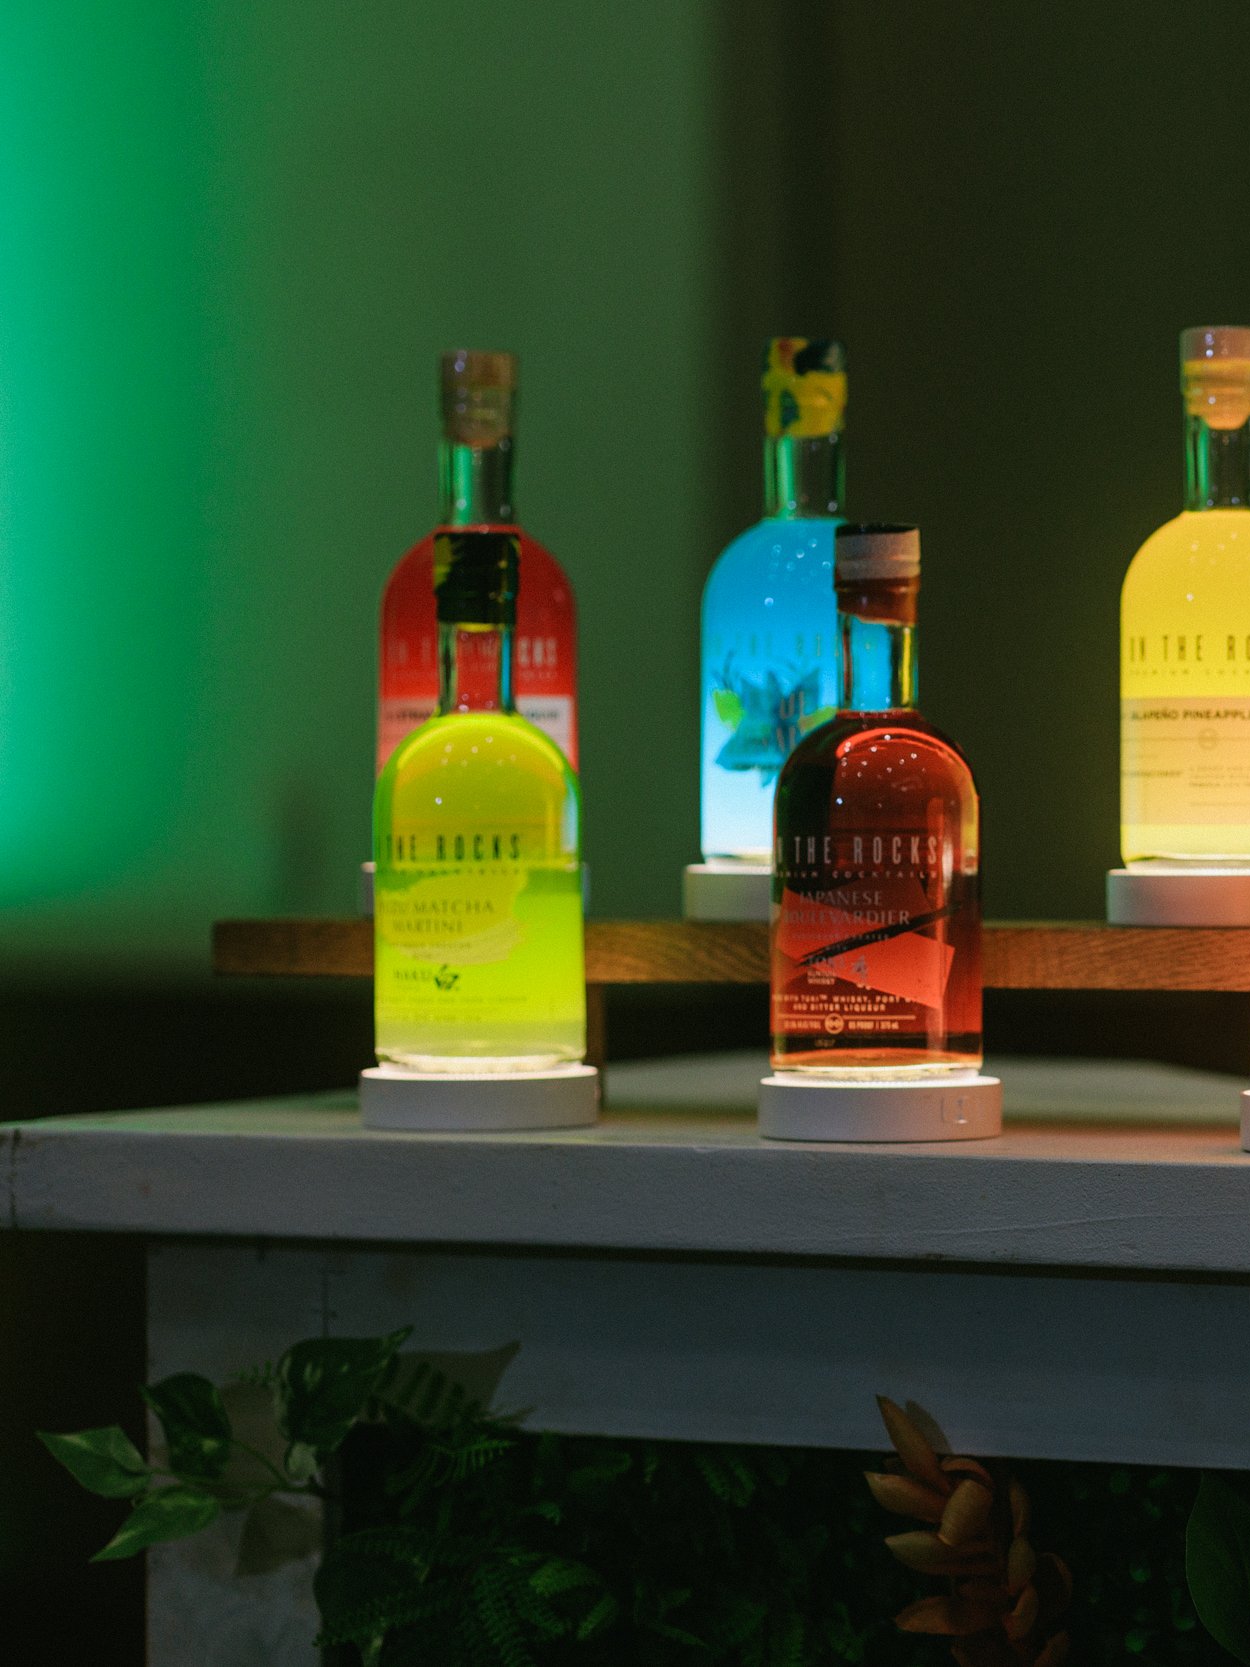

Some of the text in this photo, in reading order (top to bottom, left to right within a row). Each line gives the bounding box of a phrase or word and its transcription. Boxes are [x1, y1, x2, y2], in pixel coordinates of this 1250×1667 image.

[1161, 634, 1204, 662] THE
[436, 833, 521, 862] ROCKS
[793, 836, 832, 865] THE
[853, 836, 938, 865] ROCKS
[832, 870, 939, 879] COCKTAILS
[799, 890, 884, 907] JAPANESE
